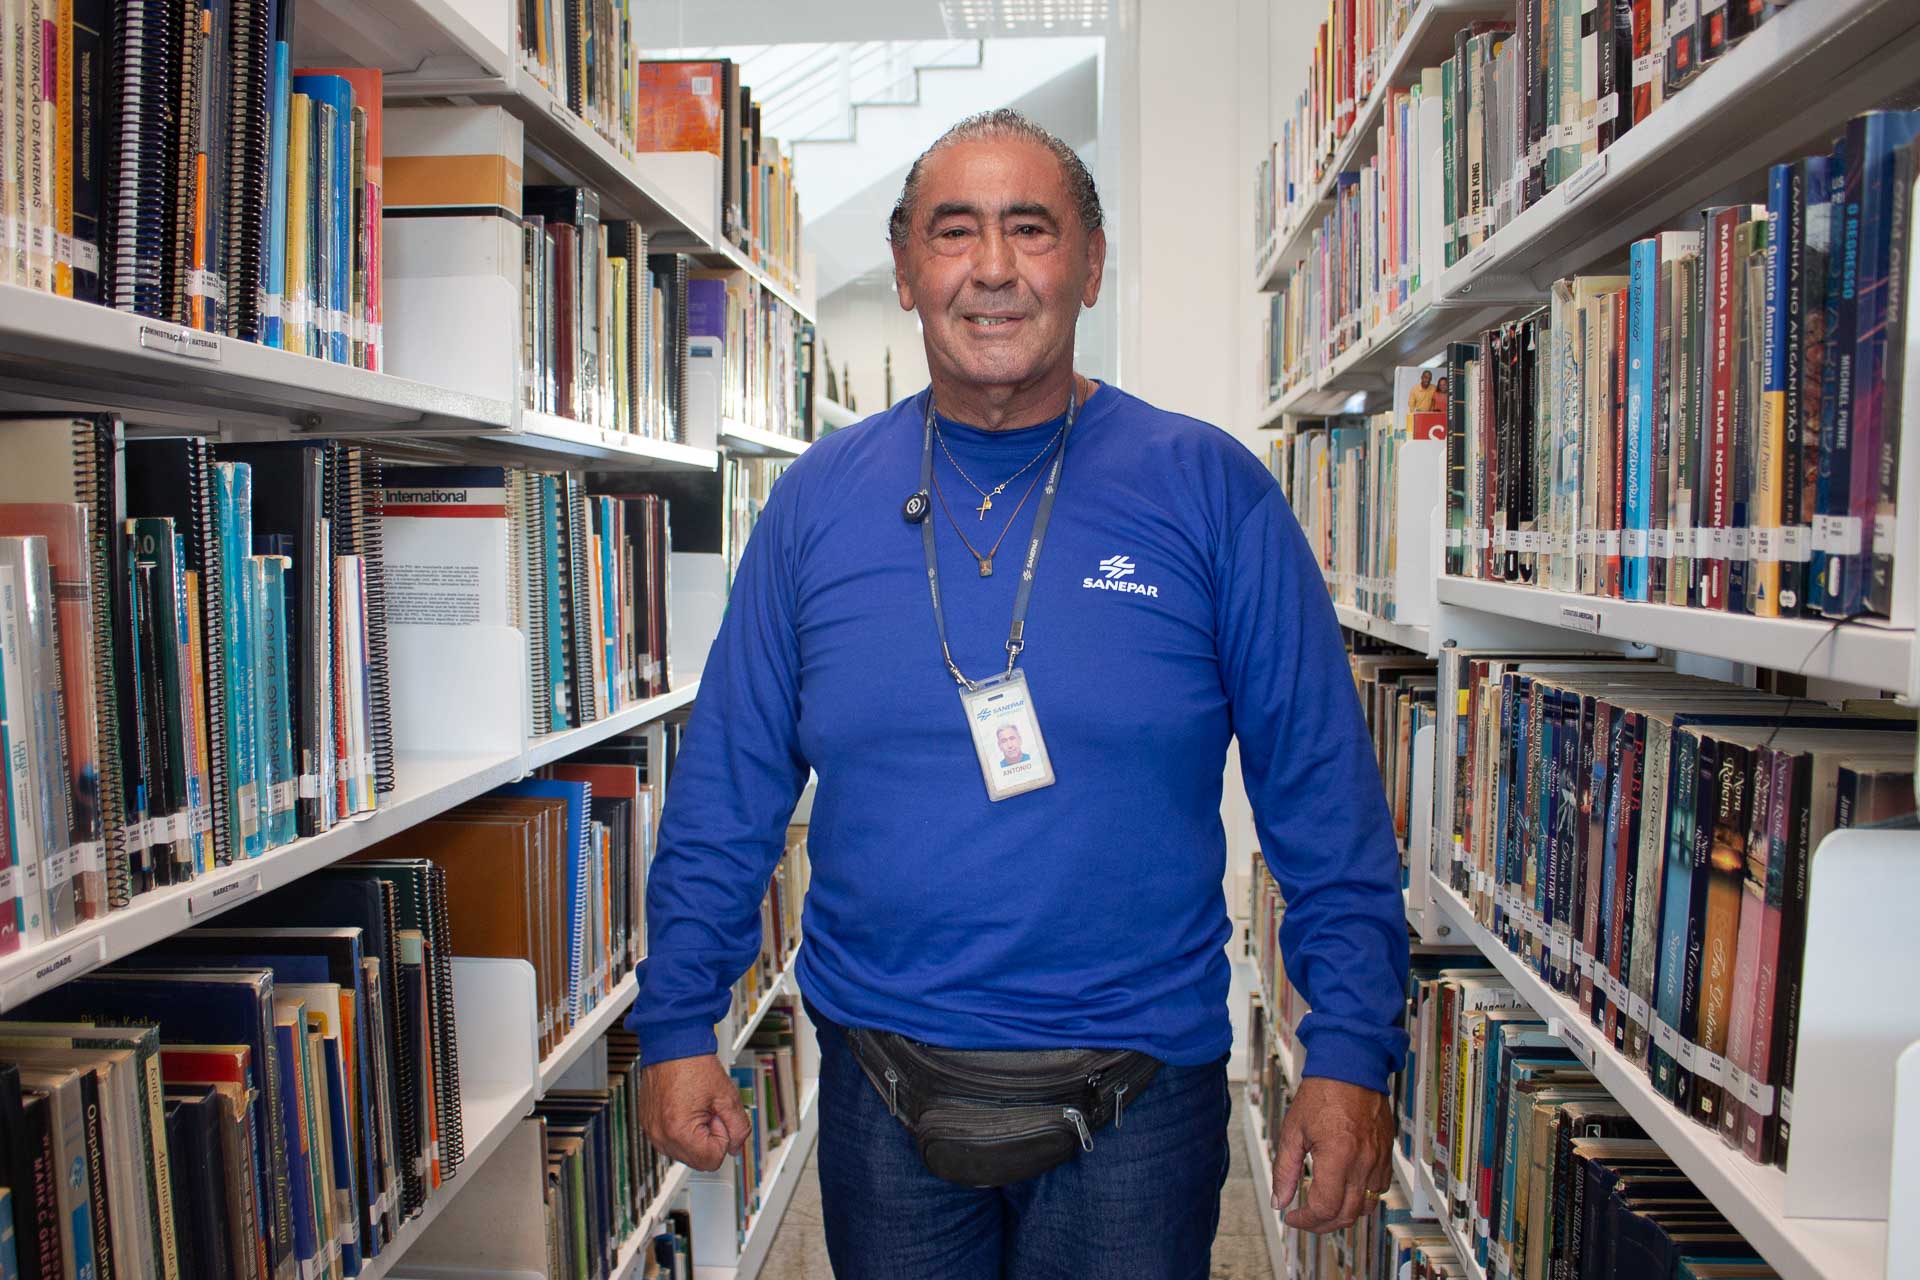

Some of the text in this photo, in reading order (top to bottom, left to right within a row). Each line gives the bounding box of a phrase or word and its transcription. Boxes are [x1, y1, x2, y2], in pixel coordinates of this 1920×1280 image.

[31, 119, 41, 138] DE
[31, 139, 42, 208] MATERIAIS
[1470, 162, 1481, 187] KING
[1790, 175, 1801, 281] CAMPANHA
[1842, 218, 1858, 300] REGRESSO
[1718, 223, 1730, 373] MARISHA PESSL
[1764, 211, 1779, 386] Don Quixote Americano
[1789, 287, 1800, 314] NO
[1836, 354, 1851, 449] MICHAEL PUNKE
[1713, 389, 1725, 529] FILME NOTURN
[385, 489, 467, 503] International
[1027, 538, 1040, 569] SANEPAR
[1082, 577, 1159, 598] SANEPAR
[993, 699, 1025, 714] SANEPAR
[1534, 692, 1543, 762] NORA ROBERTS
[1003, 762, 1032, 777] ANTONIO
[1609, 726, 1623, 833] Nora Roberts
[1718, 757, 1745, 818] Nora Roberts
[1548, 836, 1558, 900] MANHATTAN
[1693, 825, 1709, 868] Nora Roberts
[213, 881, 240, 897] MARKETING
[35, 955, 73, 979] QUALIDADE
[1751, 1033, 1767, 1081] Secre
[149, 1066, 159, 1108] Kotler
[1440, 1043, 1453, 1134] CONVERGENTE
[1504, 1121, 1516, 1165] Segal
[33, 1156, 47, 1205] MARK
[156, 1150, 174, 1250] Administração
[1570, 1164, 1585, 1259] SIDNEY SHELDON
